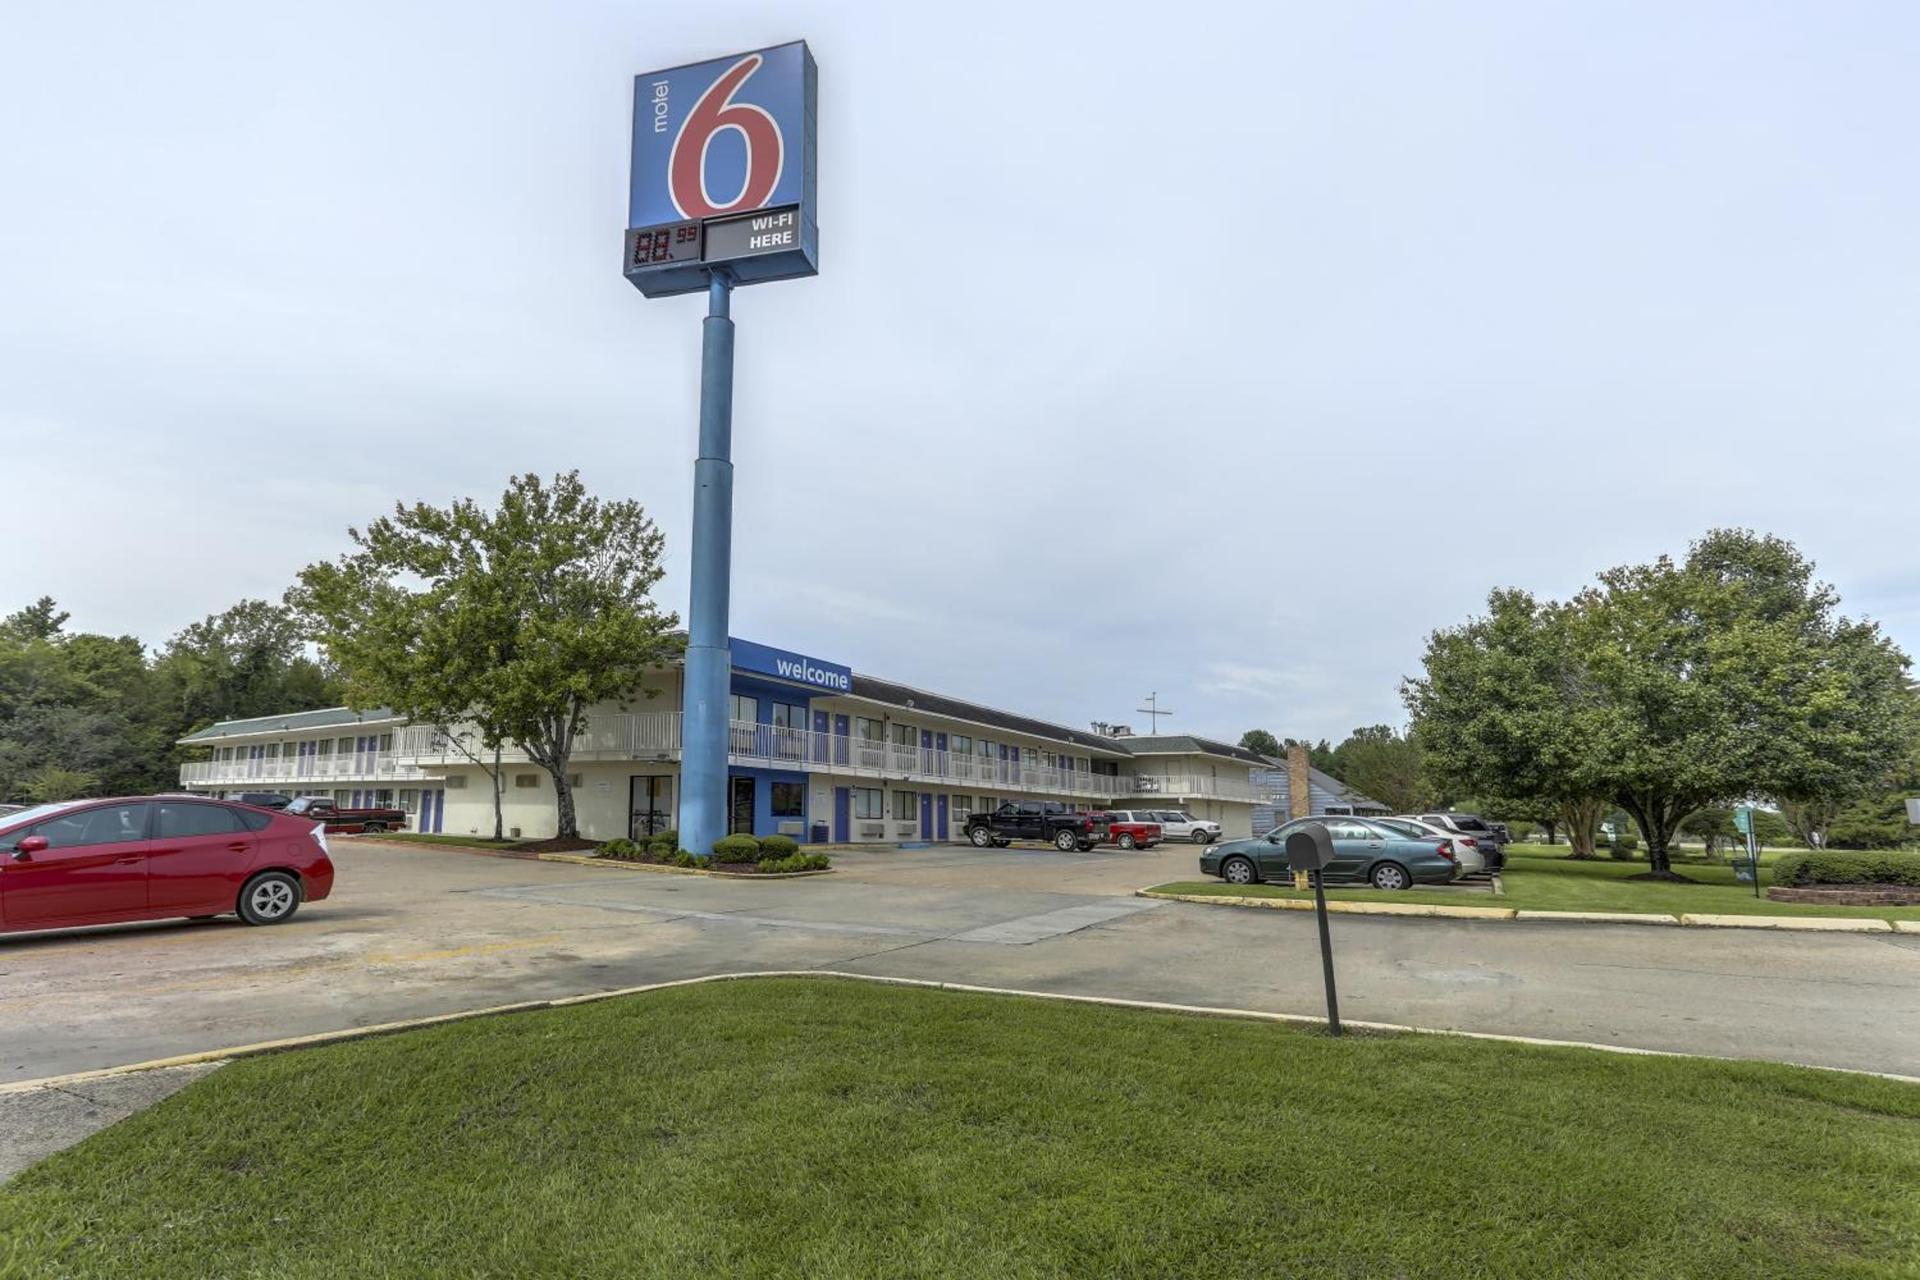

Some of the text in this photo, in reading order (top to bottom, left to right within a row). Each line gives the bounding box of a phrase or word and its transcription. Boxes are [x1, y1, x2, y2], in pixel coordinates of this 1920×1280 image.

[651, 53, 784, 221] motel 6
[752, 213, 793, 231] WI-FI
[750, 231, 792, 249] HERE
[776, 658, 849, 689] welcome
